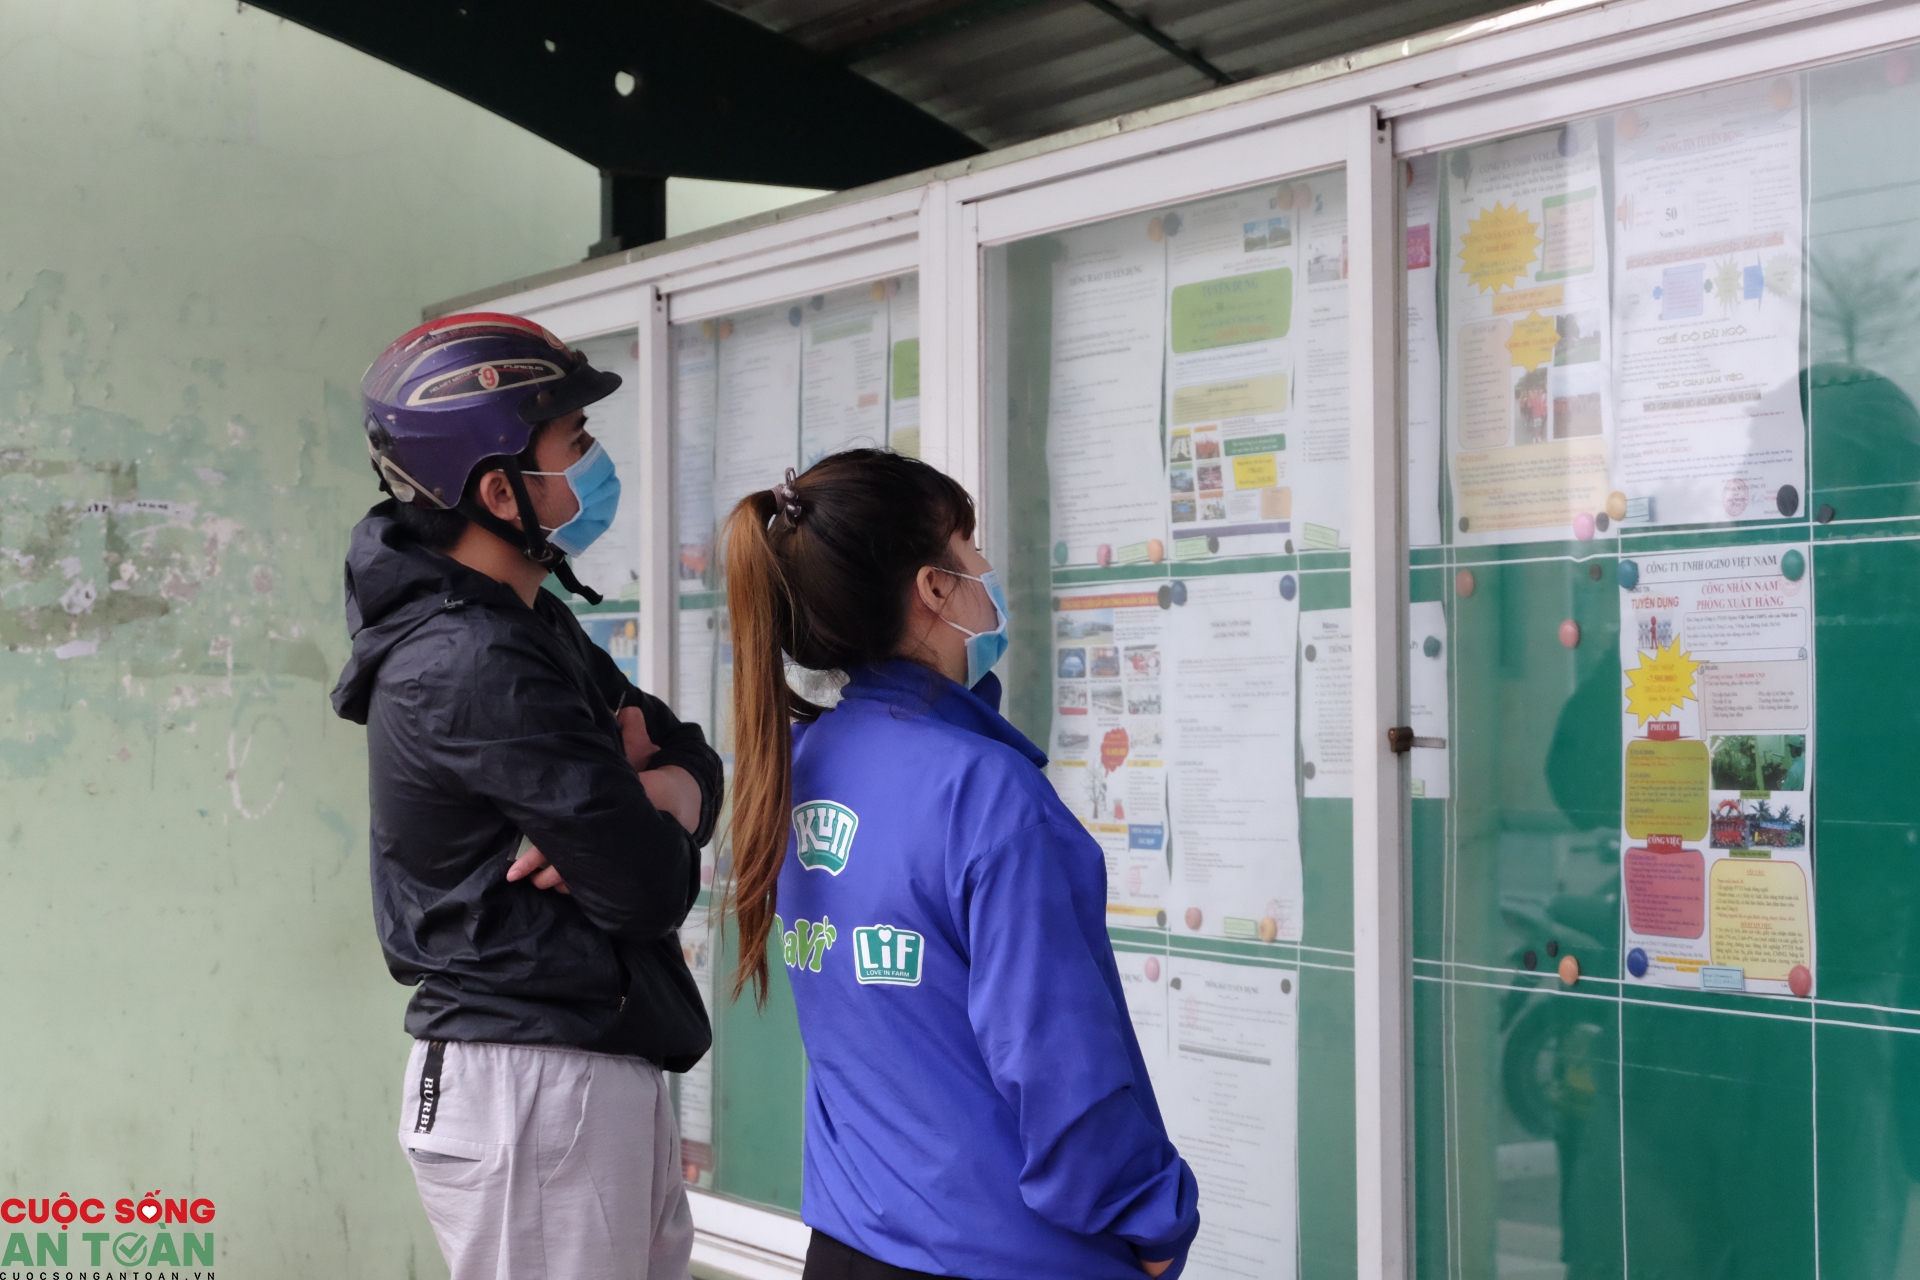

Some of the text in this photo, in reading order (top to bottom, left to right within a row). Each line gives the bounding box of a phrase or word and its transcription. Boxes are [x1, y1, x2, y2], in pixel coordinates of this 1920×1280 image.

[1665, 206, 1678, 221] 50
[482, 368, 496, 387] 9
[1645, 555, 1778, 574] CÔNG TY TNHH OGINO VIỆT NAM
[1701, 580, 1779, 595] CÔNG NHÂN NAM
[1696, 596, 1725, 610] PHÒNG
[1755, 594, 1784, 608] HÀNG
[1648, 834, 1665, 844] CÔNG
